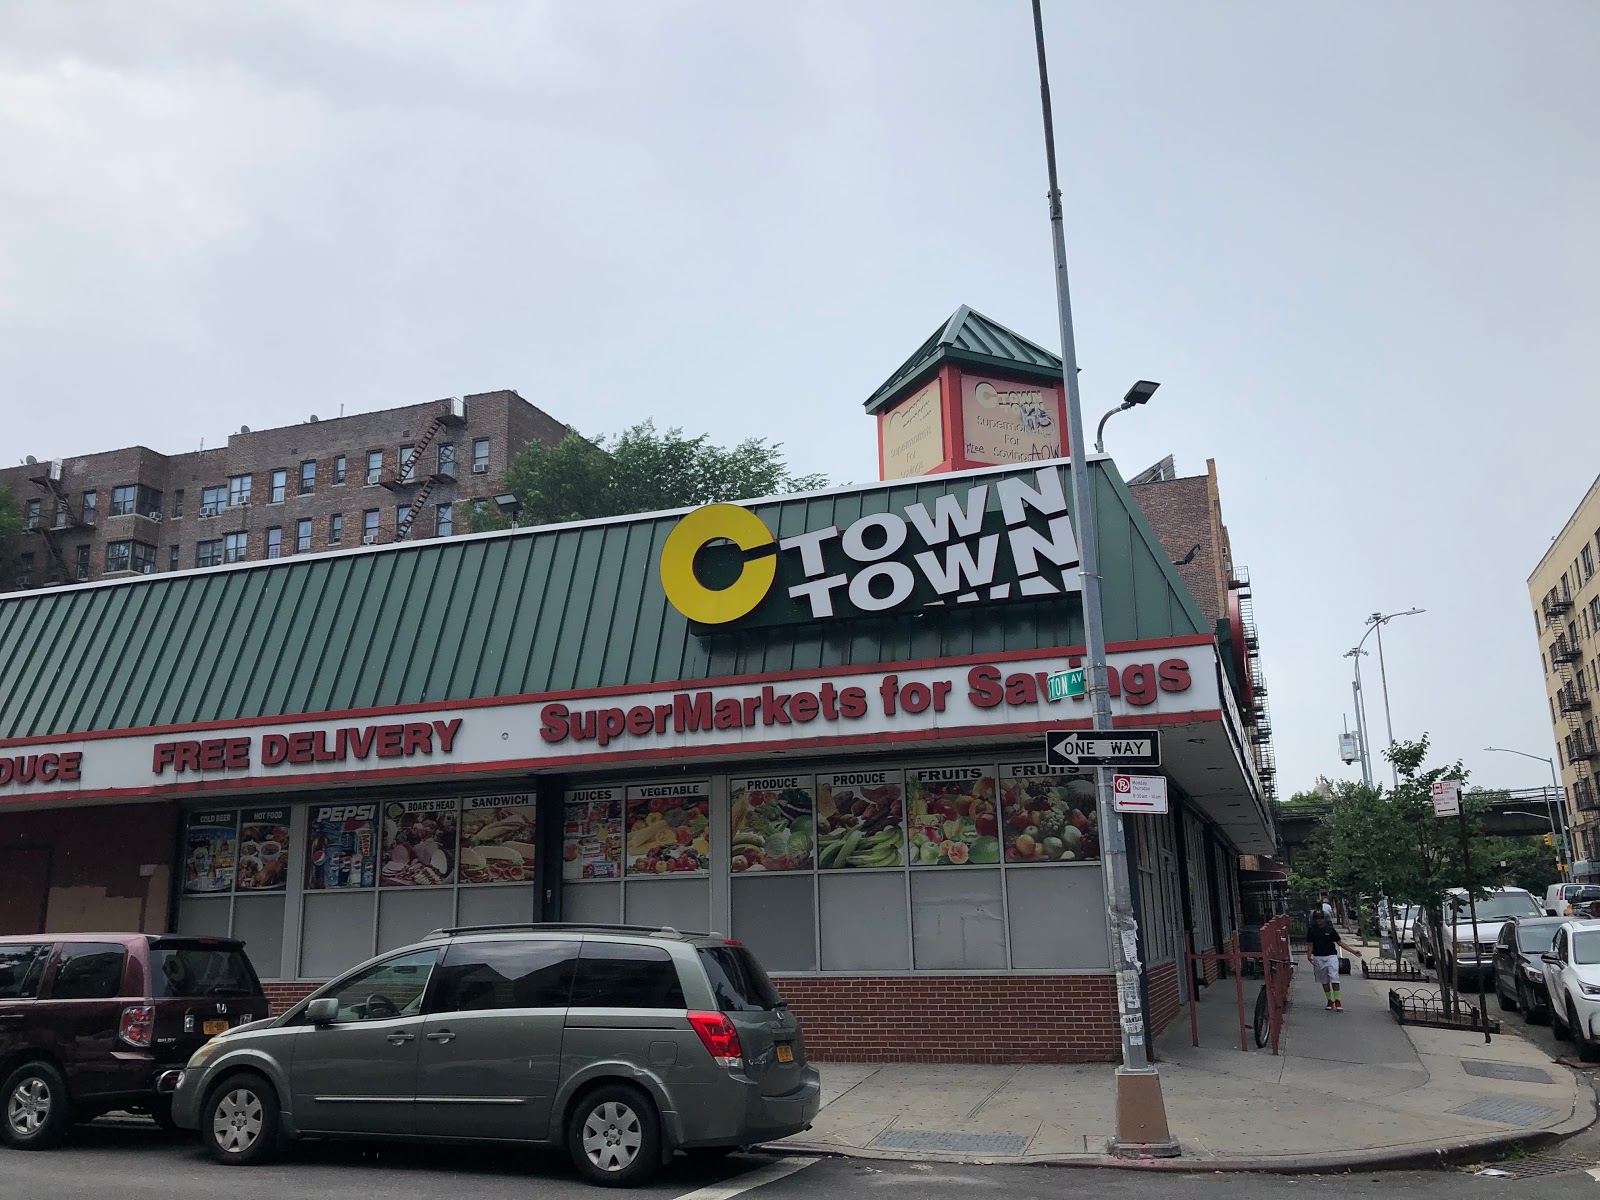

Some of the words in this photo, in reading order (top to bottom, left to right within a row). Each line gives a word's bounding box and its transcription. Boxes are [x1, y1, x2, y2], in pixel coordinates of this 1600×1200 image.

[788, 518, 1080, 618] TOWN
[1071, 672, 1082, 684] AV
[539, 682, 868, 745] SuperMarkets
[880, 674, 953, 715] for
[152, 736, 251, 774] FREE
[261, 718, 462, 766] DELIVERY
[1064, 741, 1096, 755] ONE
[1110, 741, 1144, 755] WAY
[833, 773, 886, 786] PRODUCE
[917, 768, 983, 782] FRUITS
[747, 778, 798, 790] PRODUCE
[572, 790, 612, 801] JUICES
[640, 785, 700, 797] VEGETABLE
[407, 801, 434, 812] BOAR'S
[436, 800, 455, 810] HEAD
[471, 795, 529, 808] SANDWICH
[200, 815, 215, 823] COLD
[216, 814, 231, 822] BEER
[254, 812, 266, 820] HOT
[267, 811, 282, 819] FOOD
[317, 804, 376, 823] PEPSI
